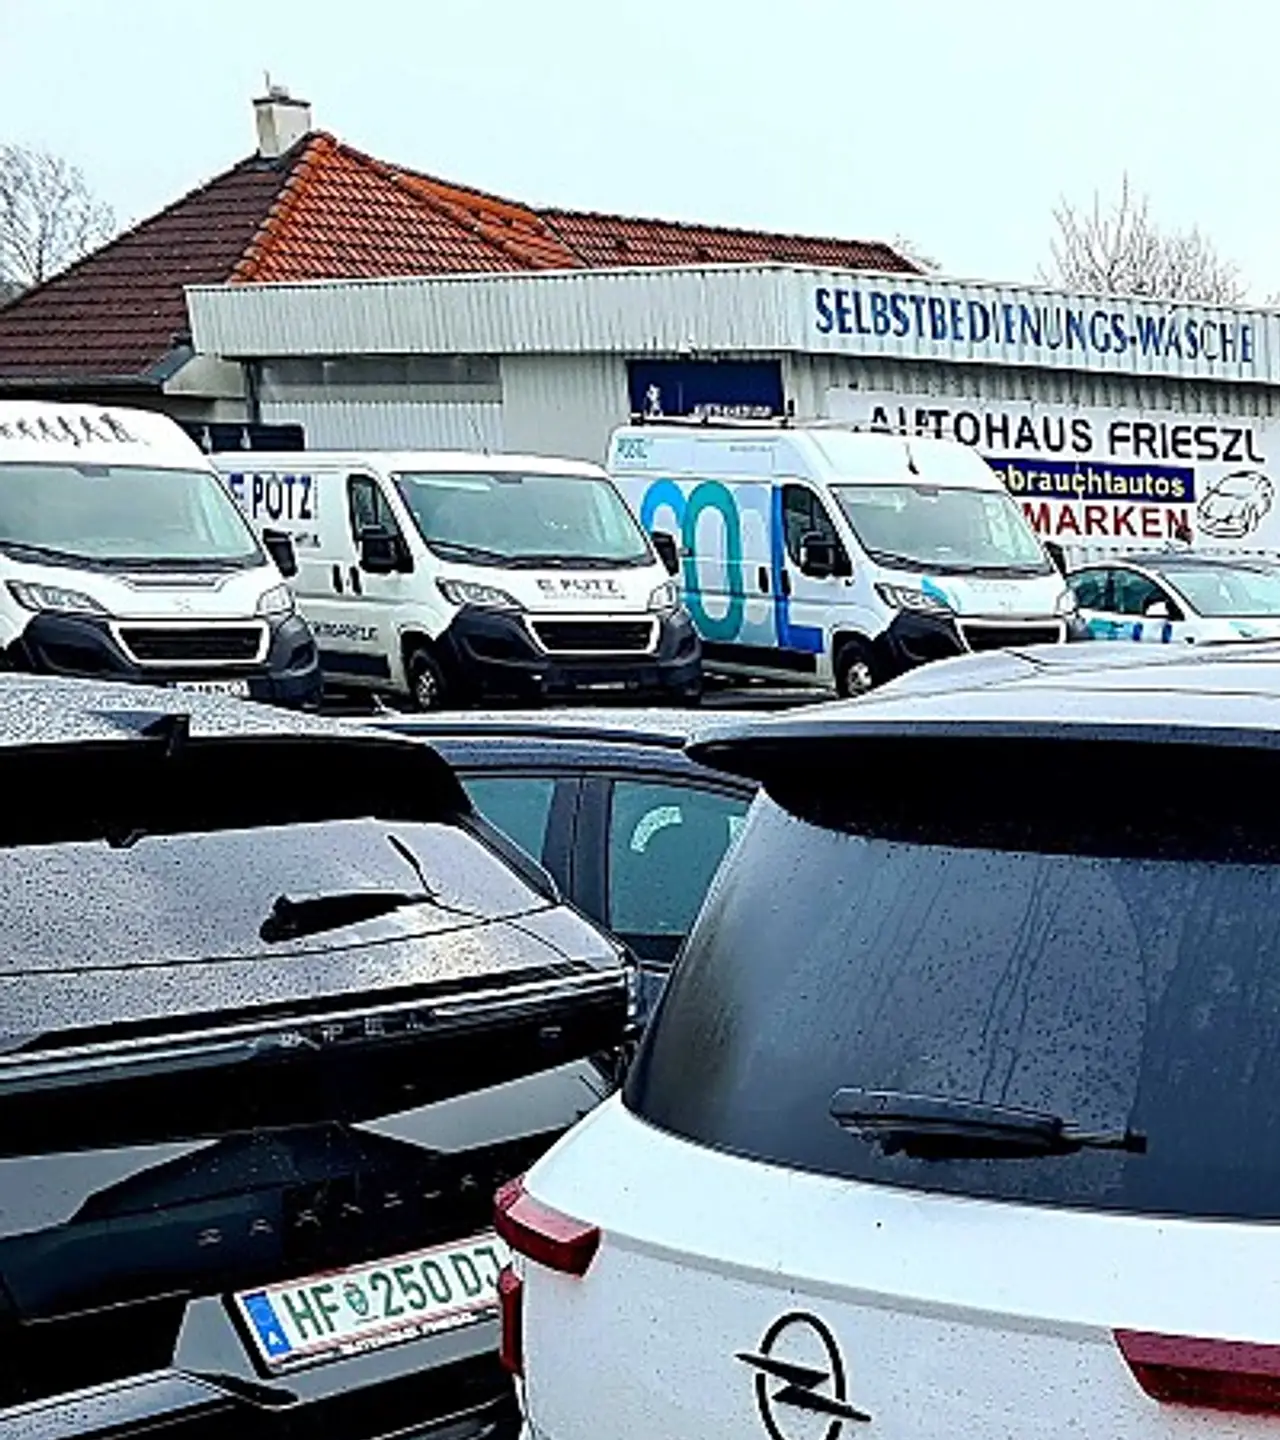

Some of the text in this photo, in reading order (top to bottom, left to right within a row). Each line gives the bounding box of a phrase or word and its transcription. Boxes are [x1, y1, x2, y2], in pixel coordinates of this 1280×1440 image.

[870, 405, 1266, 464] AUTOHAUS FRIESZL
[992, 468, 1187, 499] ebrauchtautos
[1021, 502, 1194, 542] MARKEN
[281, 1282, 341, 1340] HF
[372, 1259, 453, 1318] 250
